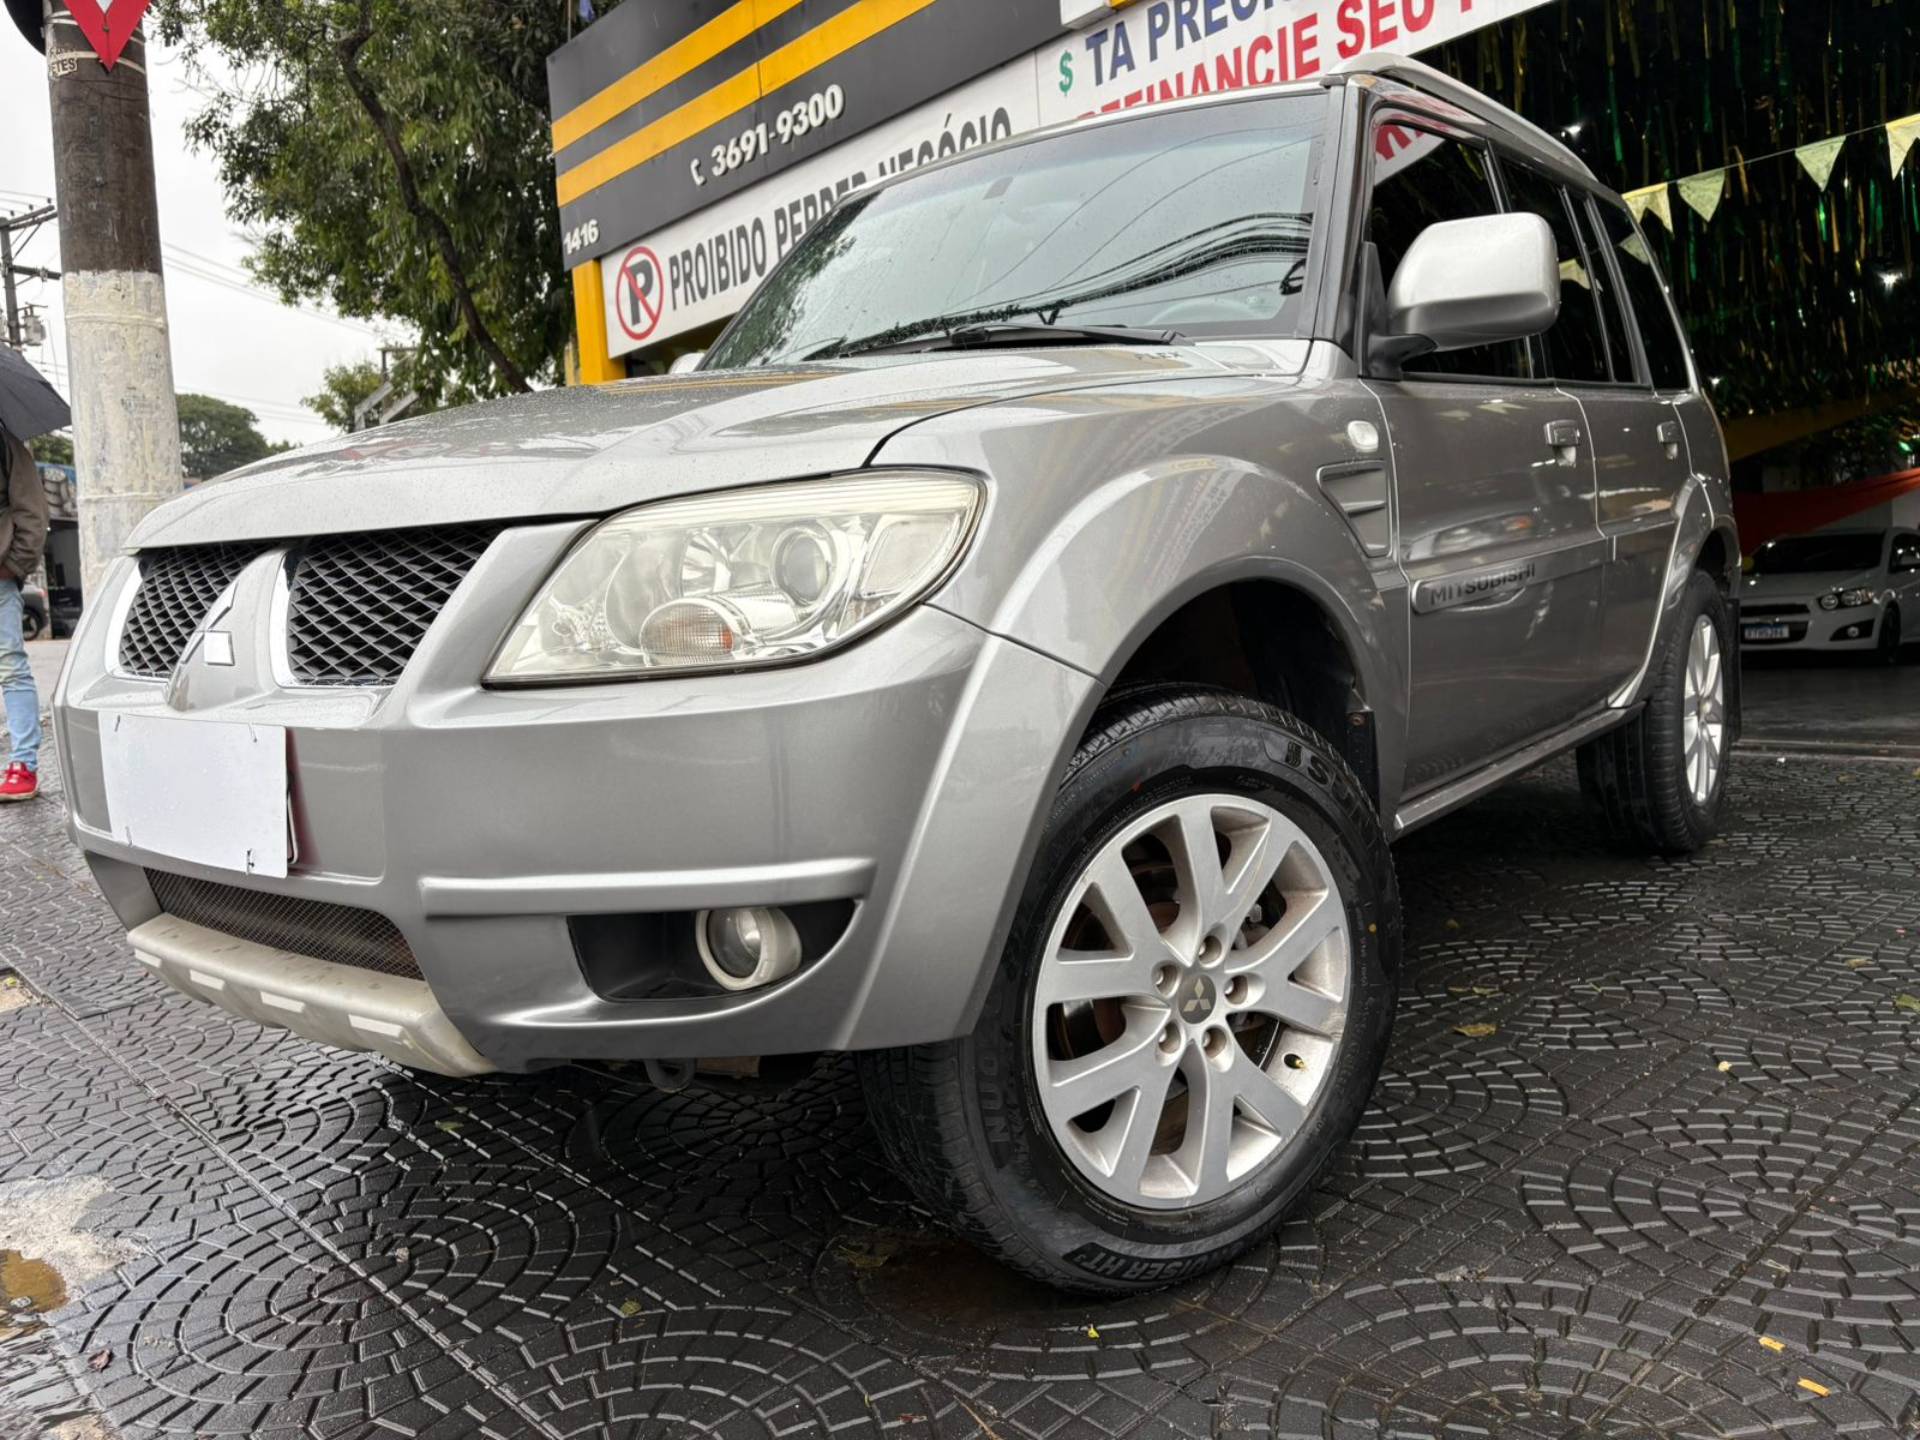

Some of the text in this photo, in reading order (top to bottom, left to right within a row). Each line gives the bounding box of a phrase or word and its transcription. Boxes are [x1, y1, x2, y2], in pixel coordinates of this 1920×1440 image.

[1058, 49, 1074, 97] $
[1147, 0, 1295, 62] PRE
[711, 84, 845, 177] 3691-9300
[563, 219, 600, 255] 1416
[668, 216, 767, 311] PROIBIDO
[773, 170, 868, 262] PERD
